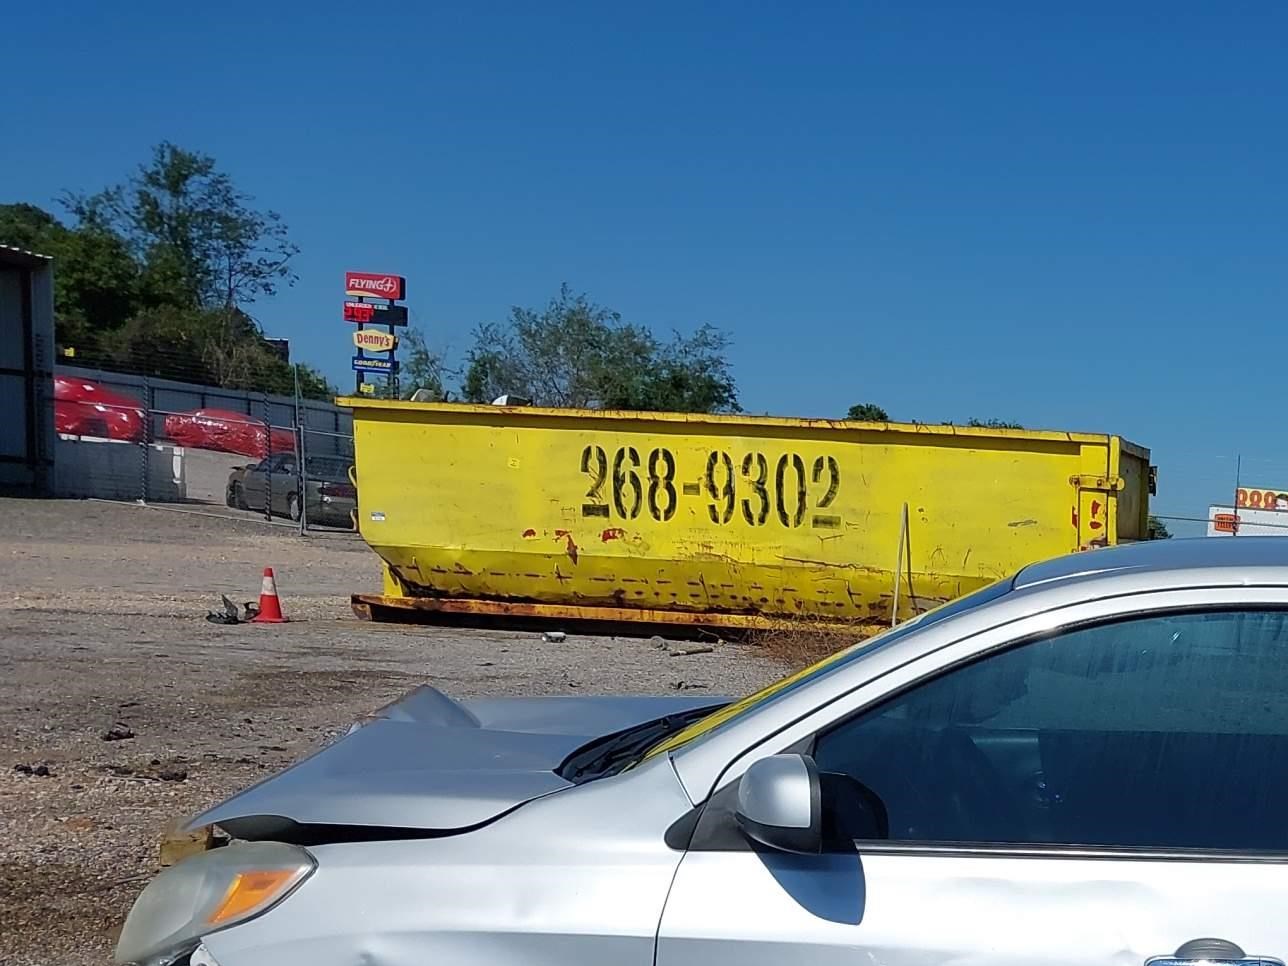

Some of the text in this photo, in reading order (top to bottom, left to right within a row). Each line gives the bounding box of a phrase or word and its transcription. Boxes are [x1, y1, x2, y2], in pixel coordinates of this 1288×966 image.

[349, 278, 384, 291] FLYING
[356, 333, 391, 347] Denny's
[580, 444, 842, 529] 268-9302
